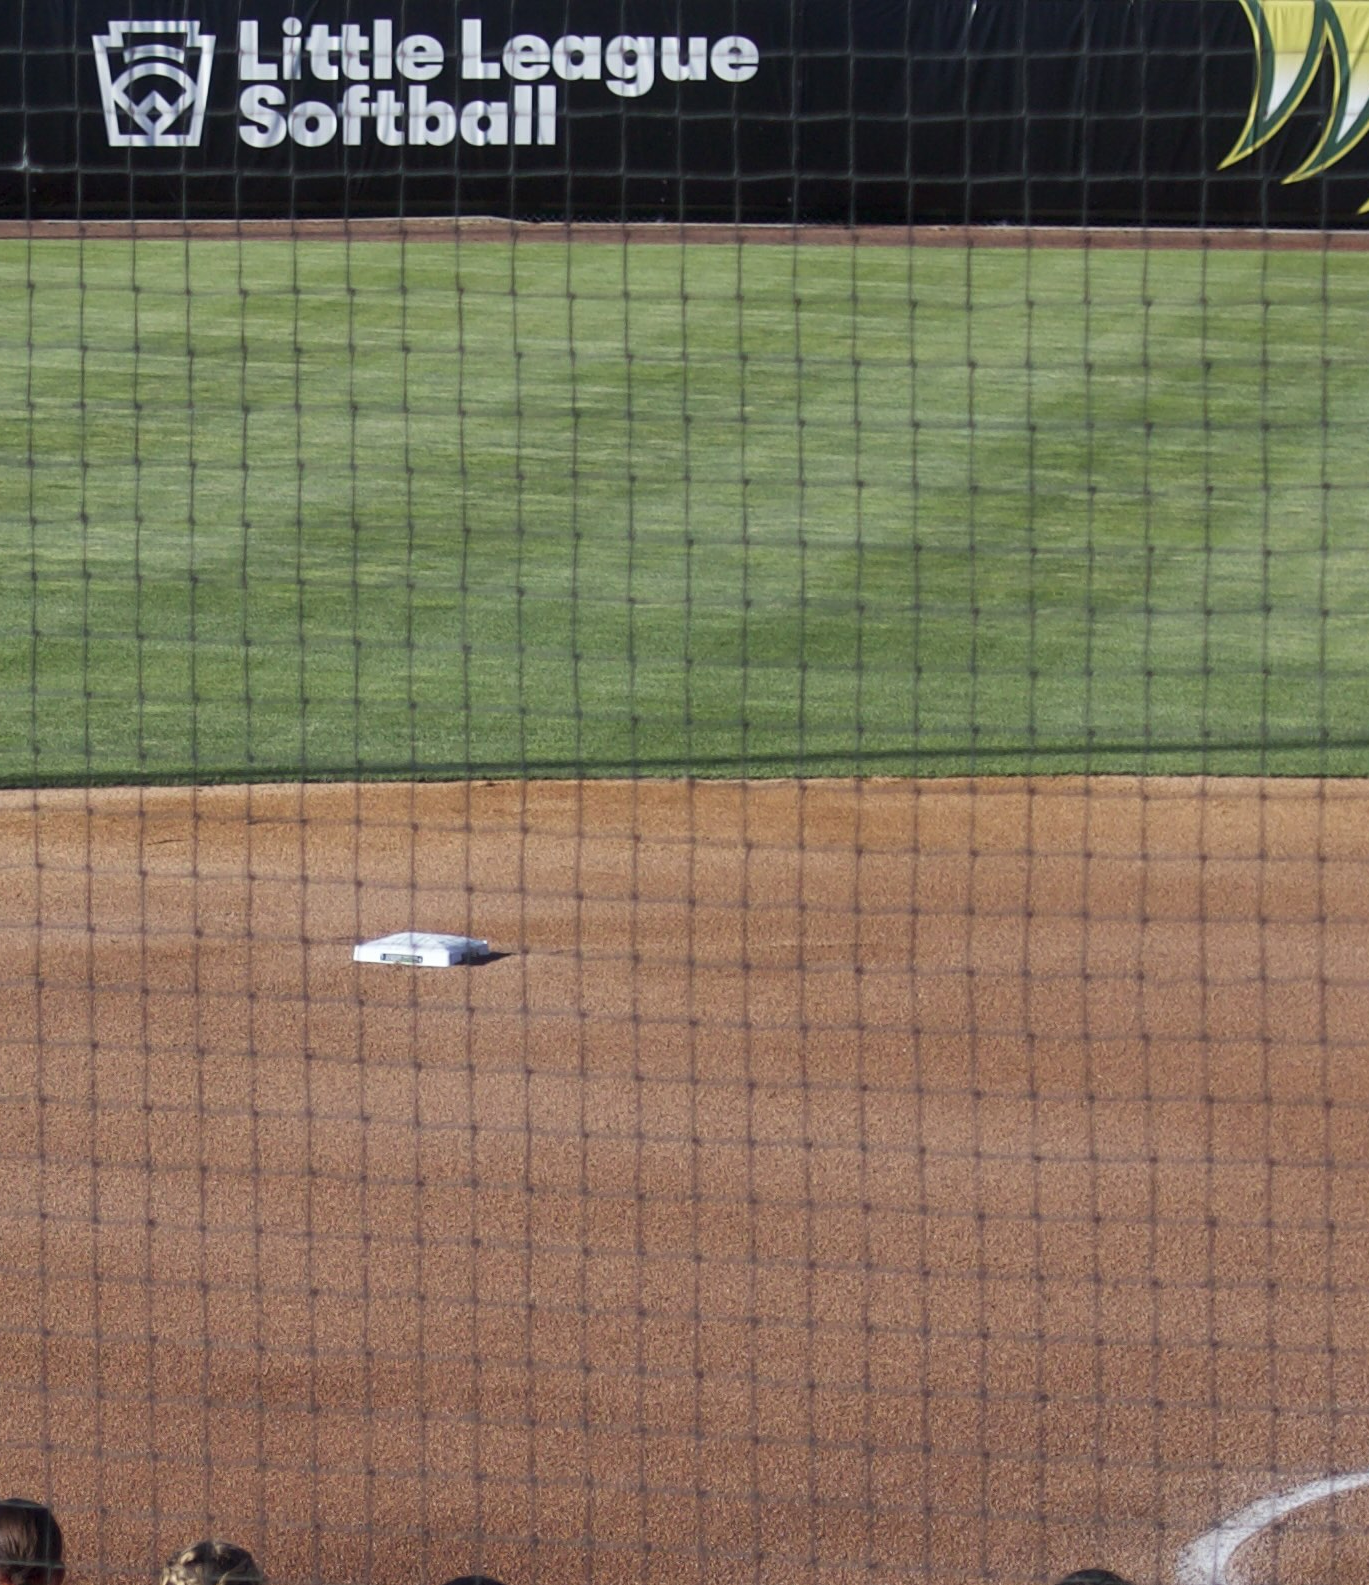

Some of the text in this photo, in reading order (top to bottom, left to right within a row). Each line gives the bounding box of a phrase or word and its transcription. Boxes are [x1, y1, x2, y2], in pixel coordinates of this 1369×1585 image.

[240, 18, 760, 97] Little League
[239, 84, 557, 149] Softball
